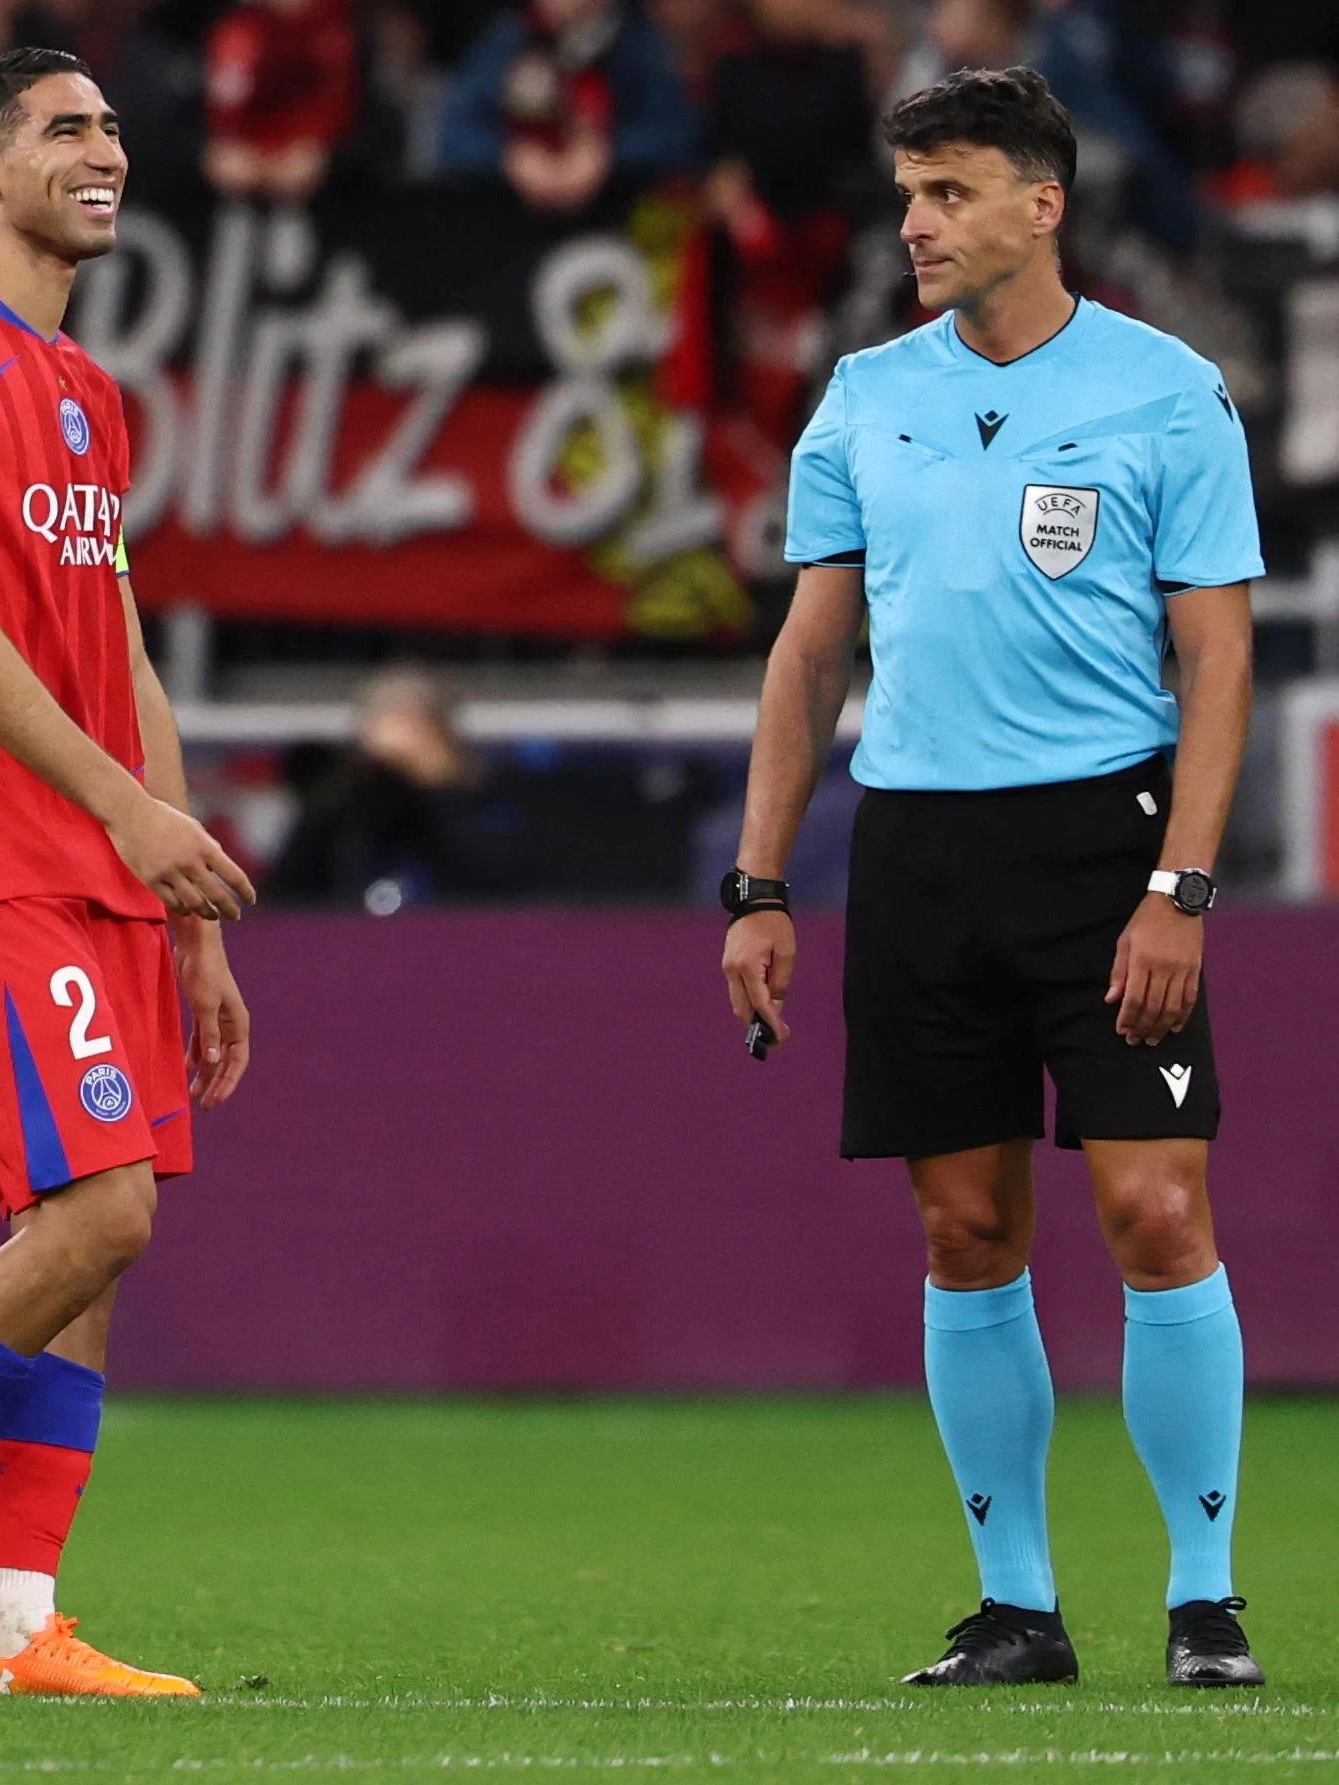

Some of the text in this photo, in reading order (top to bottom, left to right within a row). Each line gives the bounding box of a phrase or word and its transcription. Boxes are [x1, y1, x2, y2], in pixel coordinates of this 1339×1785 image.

[75, 196, 489, 548] Blitz
[1037, 496, 1081, 515] UEFA
[1036, 524, 1079, 537] MATCH
[60, 535, 117, 566] AIRW
[1030, 537, 1083, 552] OFFICIAL
[49, 965, 113, 1060] 2
[85, 1067, 117, 1085] PARIS
